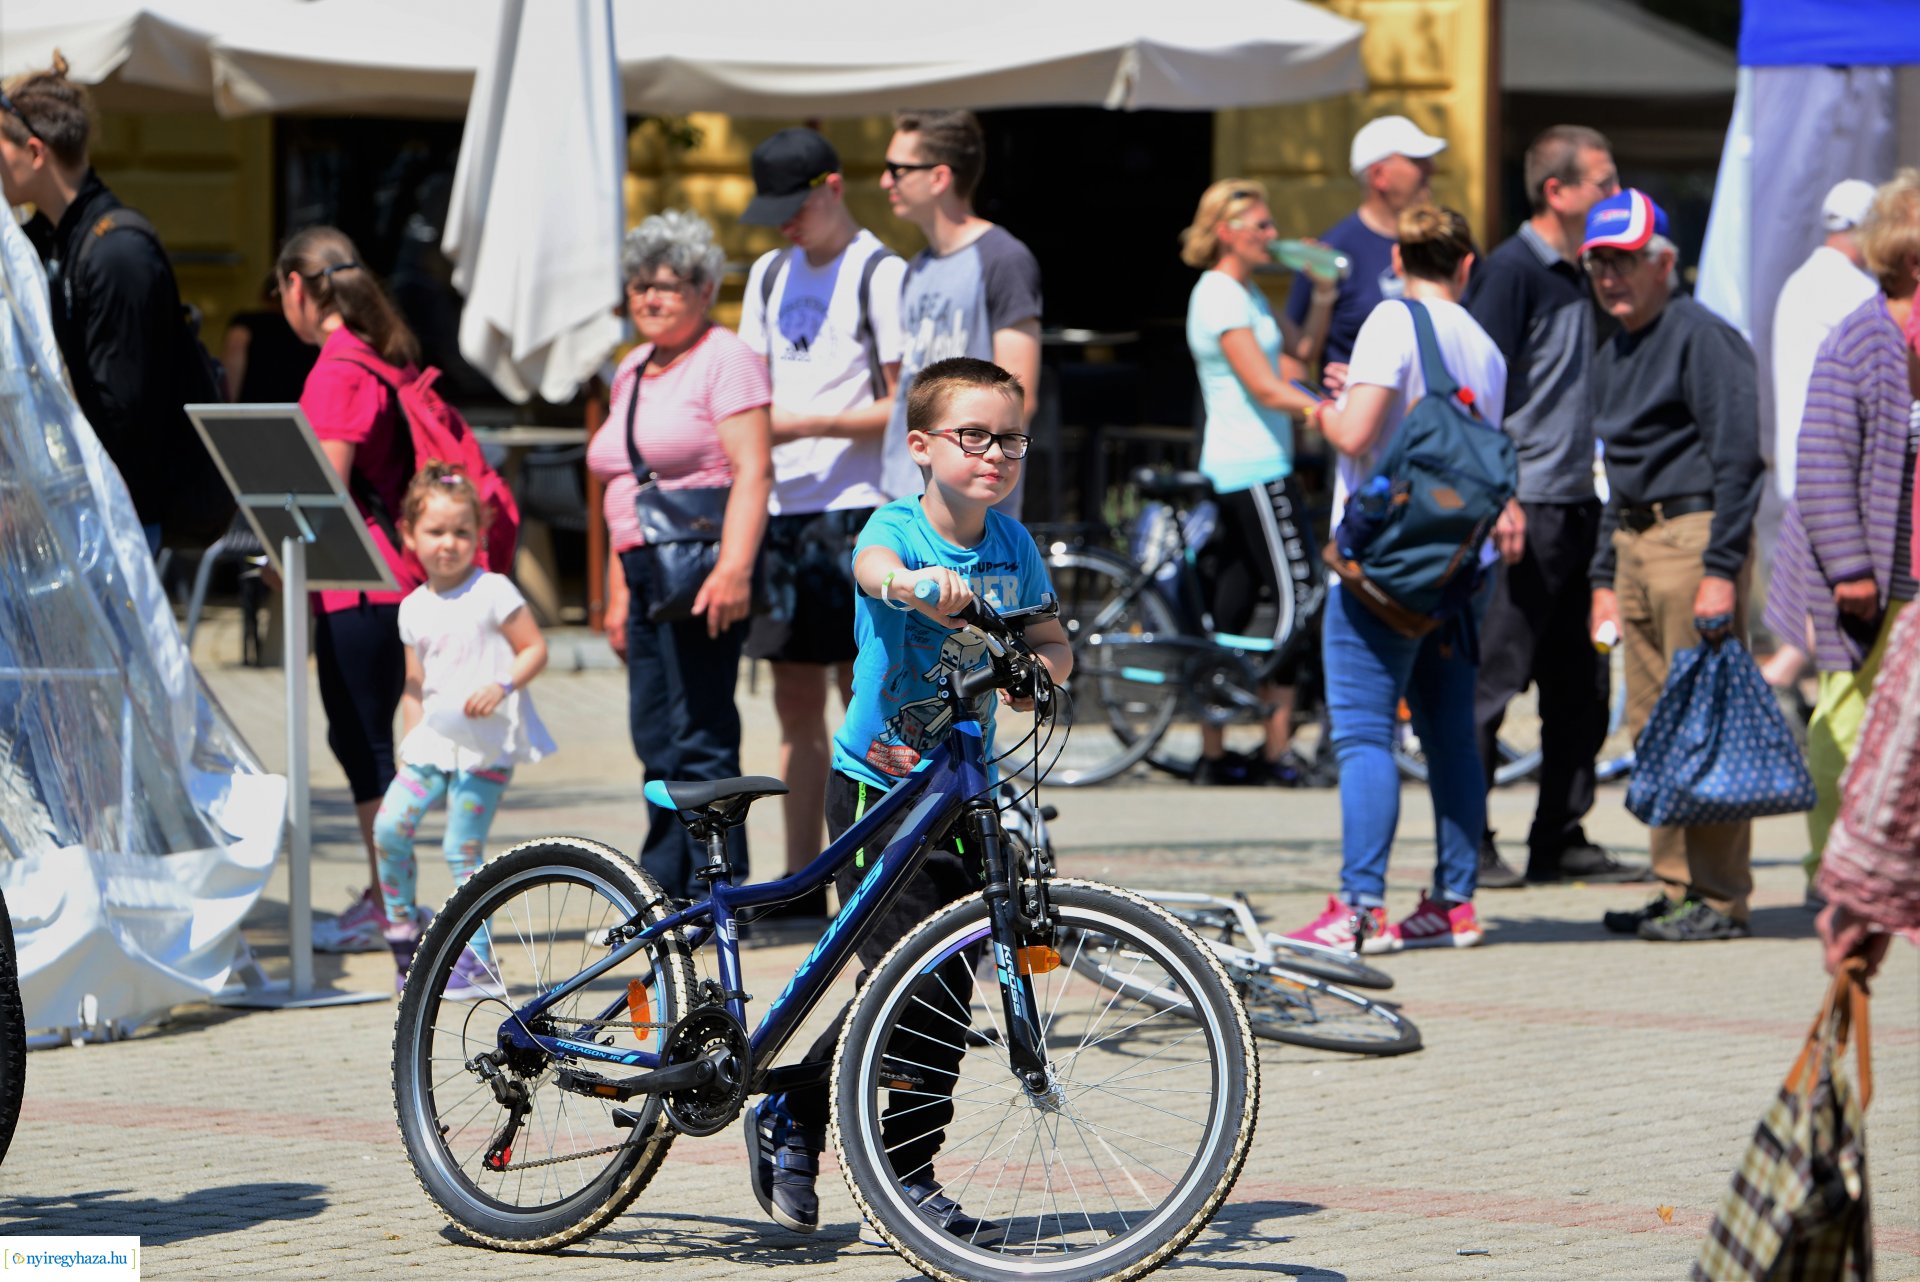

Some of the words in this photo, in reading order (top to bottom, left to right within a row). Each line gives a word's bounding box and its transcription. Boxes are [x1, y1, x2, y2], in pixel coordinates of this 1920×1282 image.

[761, 853, 884, 1028] KROSS
[1003, 944, 1022, 1018] KROSS
[557, 1041, 606, 1058] HEXAGON
